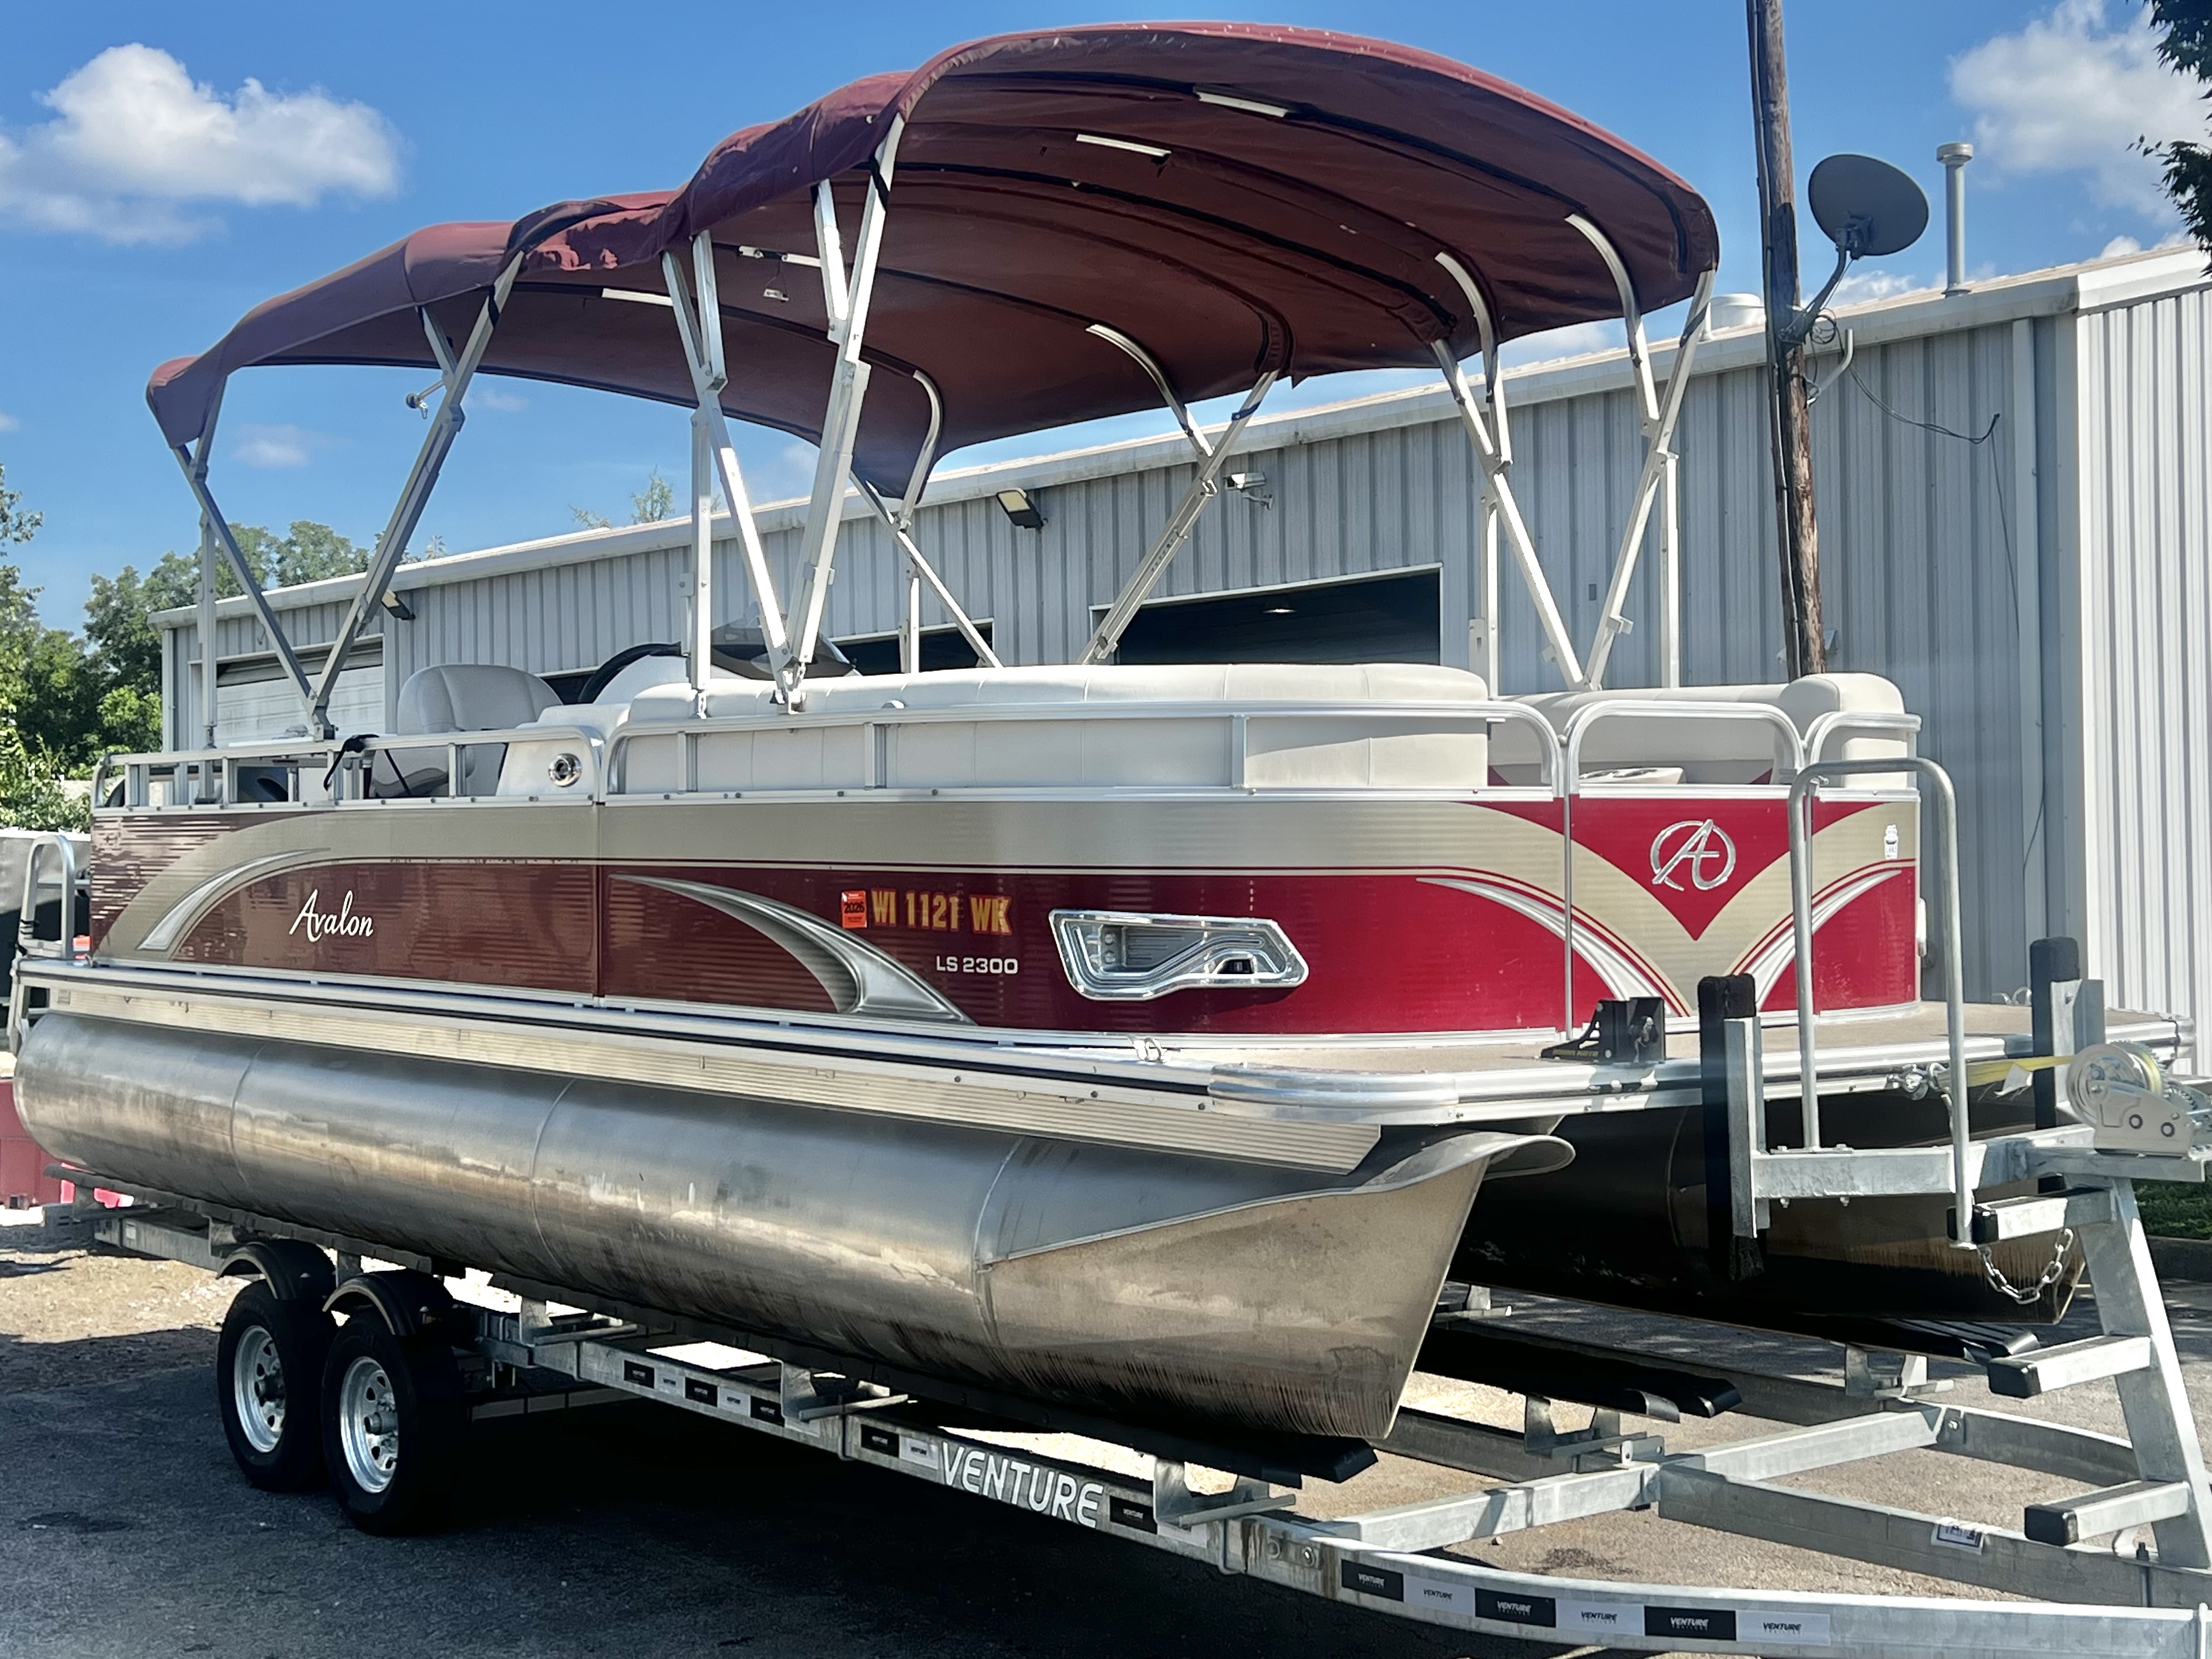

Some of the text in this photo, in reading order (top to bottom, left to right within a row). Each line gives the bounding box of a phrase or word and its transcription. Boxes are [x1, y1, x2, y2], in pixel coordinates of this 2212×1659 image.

[289, 888, 374, 942] Avalon
[871, 889, 1012, 935] WI 1121 WK
[936, 956, 1018, 974] LS 2300
[941, 1442, 1104, 1528] VENTURE
[1423, 1588, 1453, 1600] VENTURE
[1497, 1600, 1531, 1612] VENTURE
[1581, 1611, 1618, 1621] VENTURE
[1670, 1617, 1709, 1627] VENTURE
[1763, 1622, 1802, 1631] VENTURE
